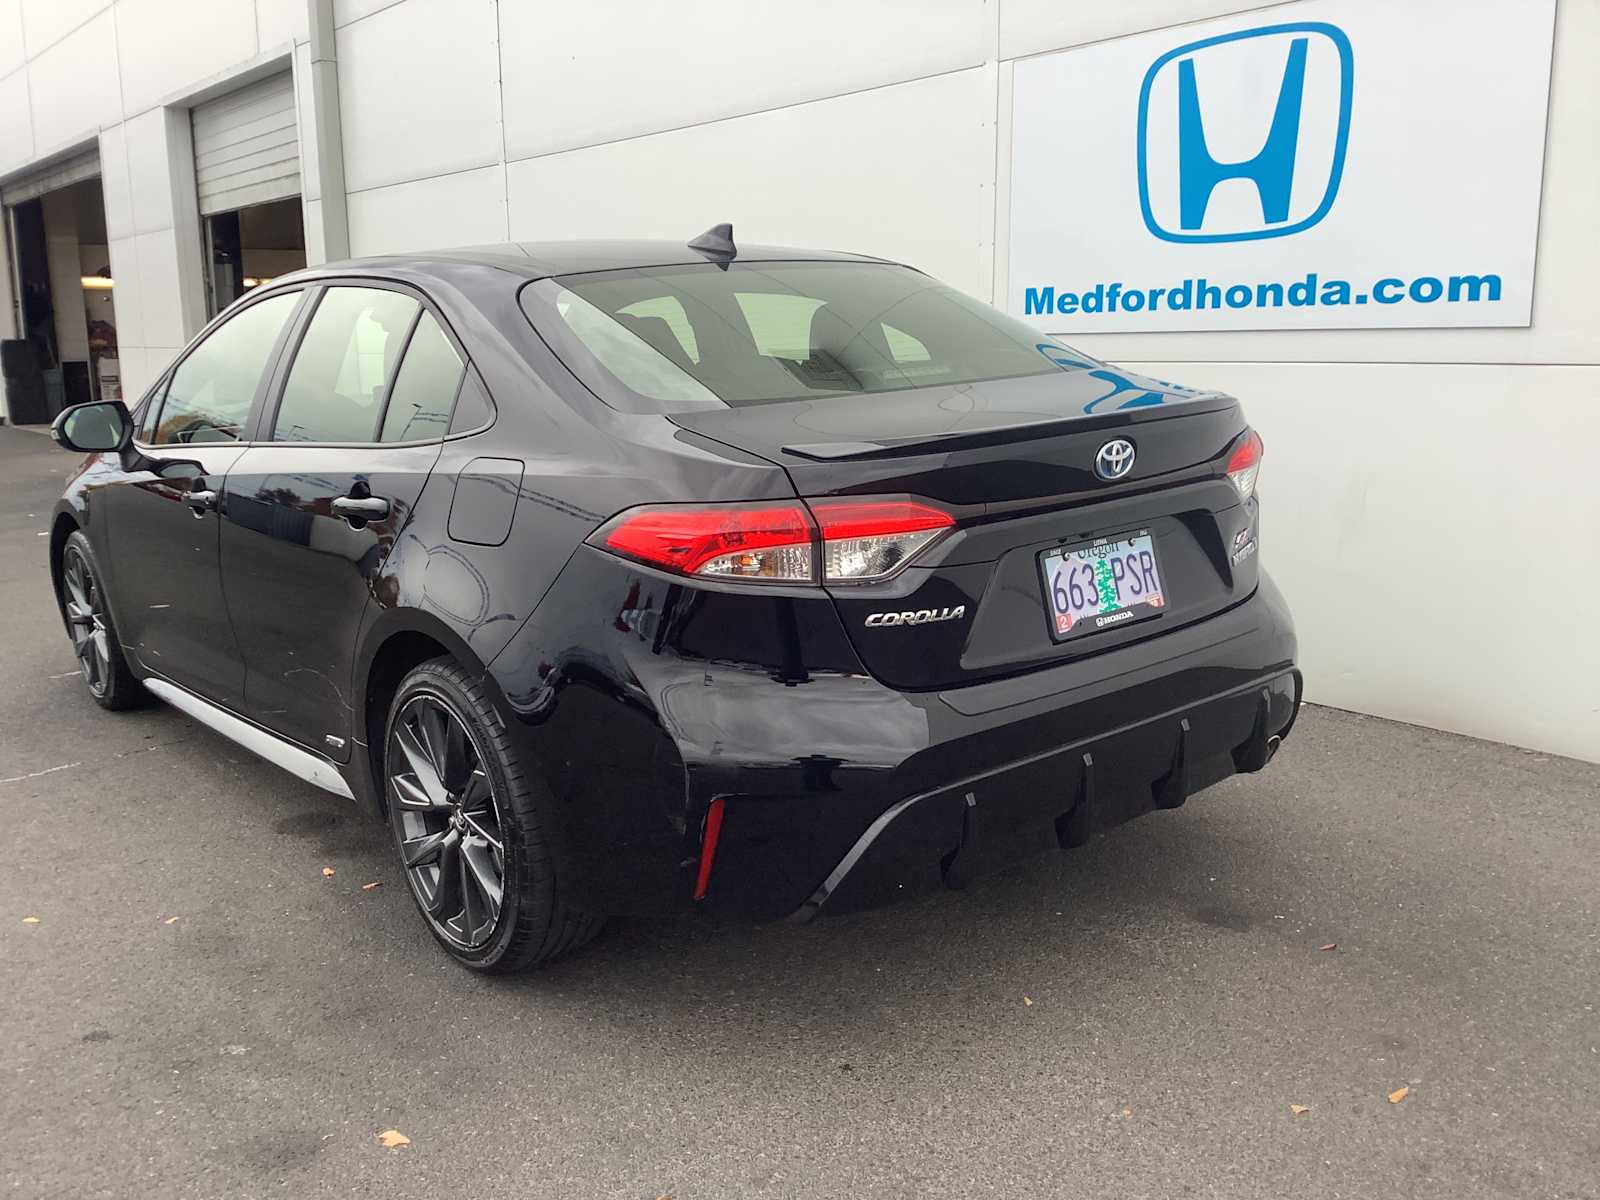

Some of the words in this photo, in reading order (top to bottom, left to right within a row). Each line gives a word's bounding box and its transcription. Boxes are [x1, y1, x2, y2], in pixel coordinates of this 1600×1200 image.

[1024, 273, 1502, 316] Medfordhonda.com
[1053, 563, 1100, 614] 663
[1110, 550, 1158, 602] PSR
[864, 605, 966, 627] COROLLA
[1060, 615, 1070, 629] 2
[1104, 611, 1134, 624] HONDA
